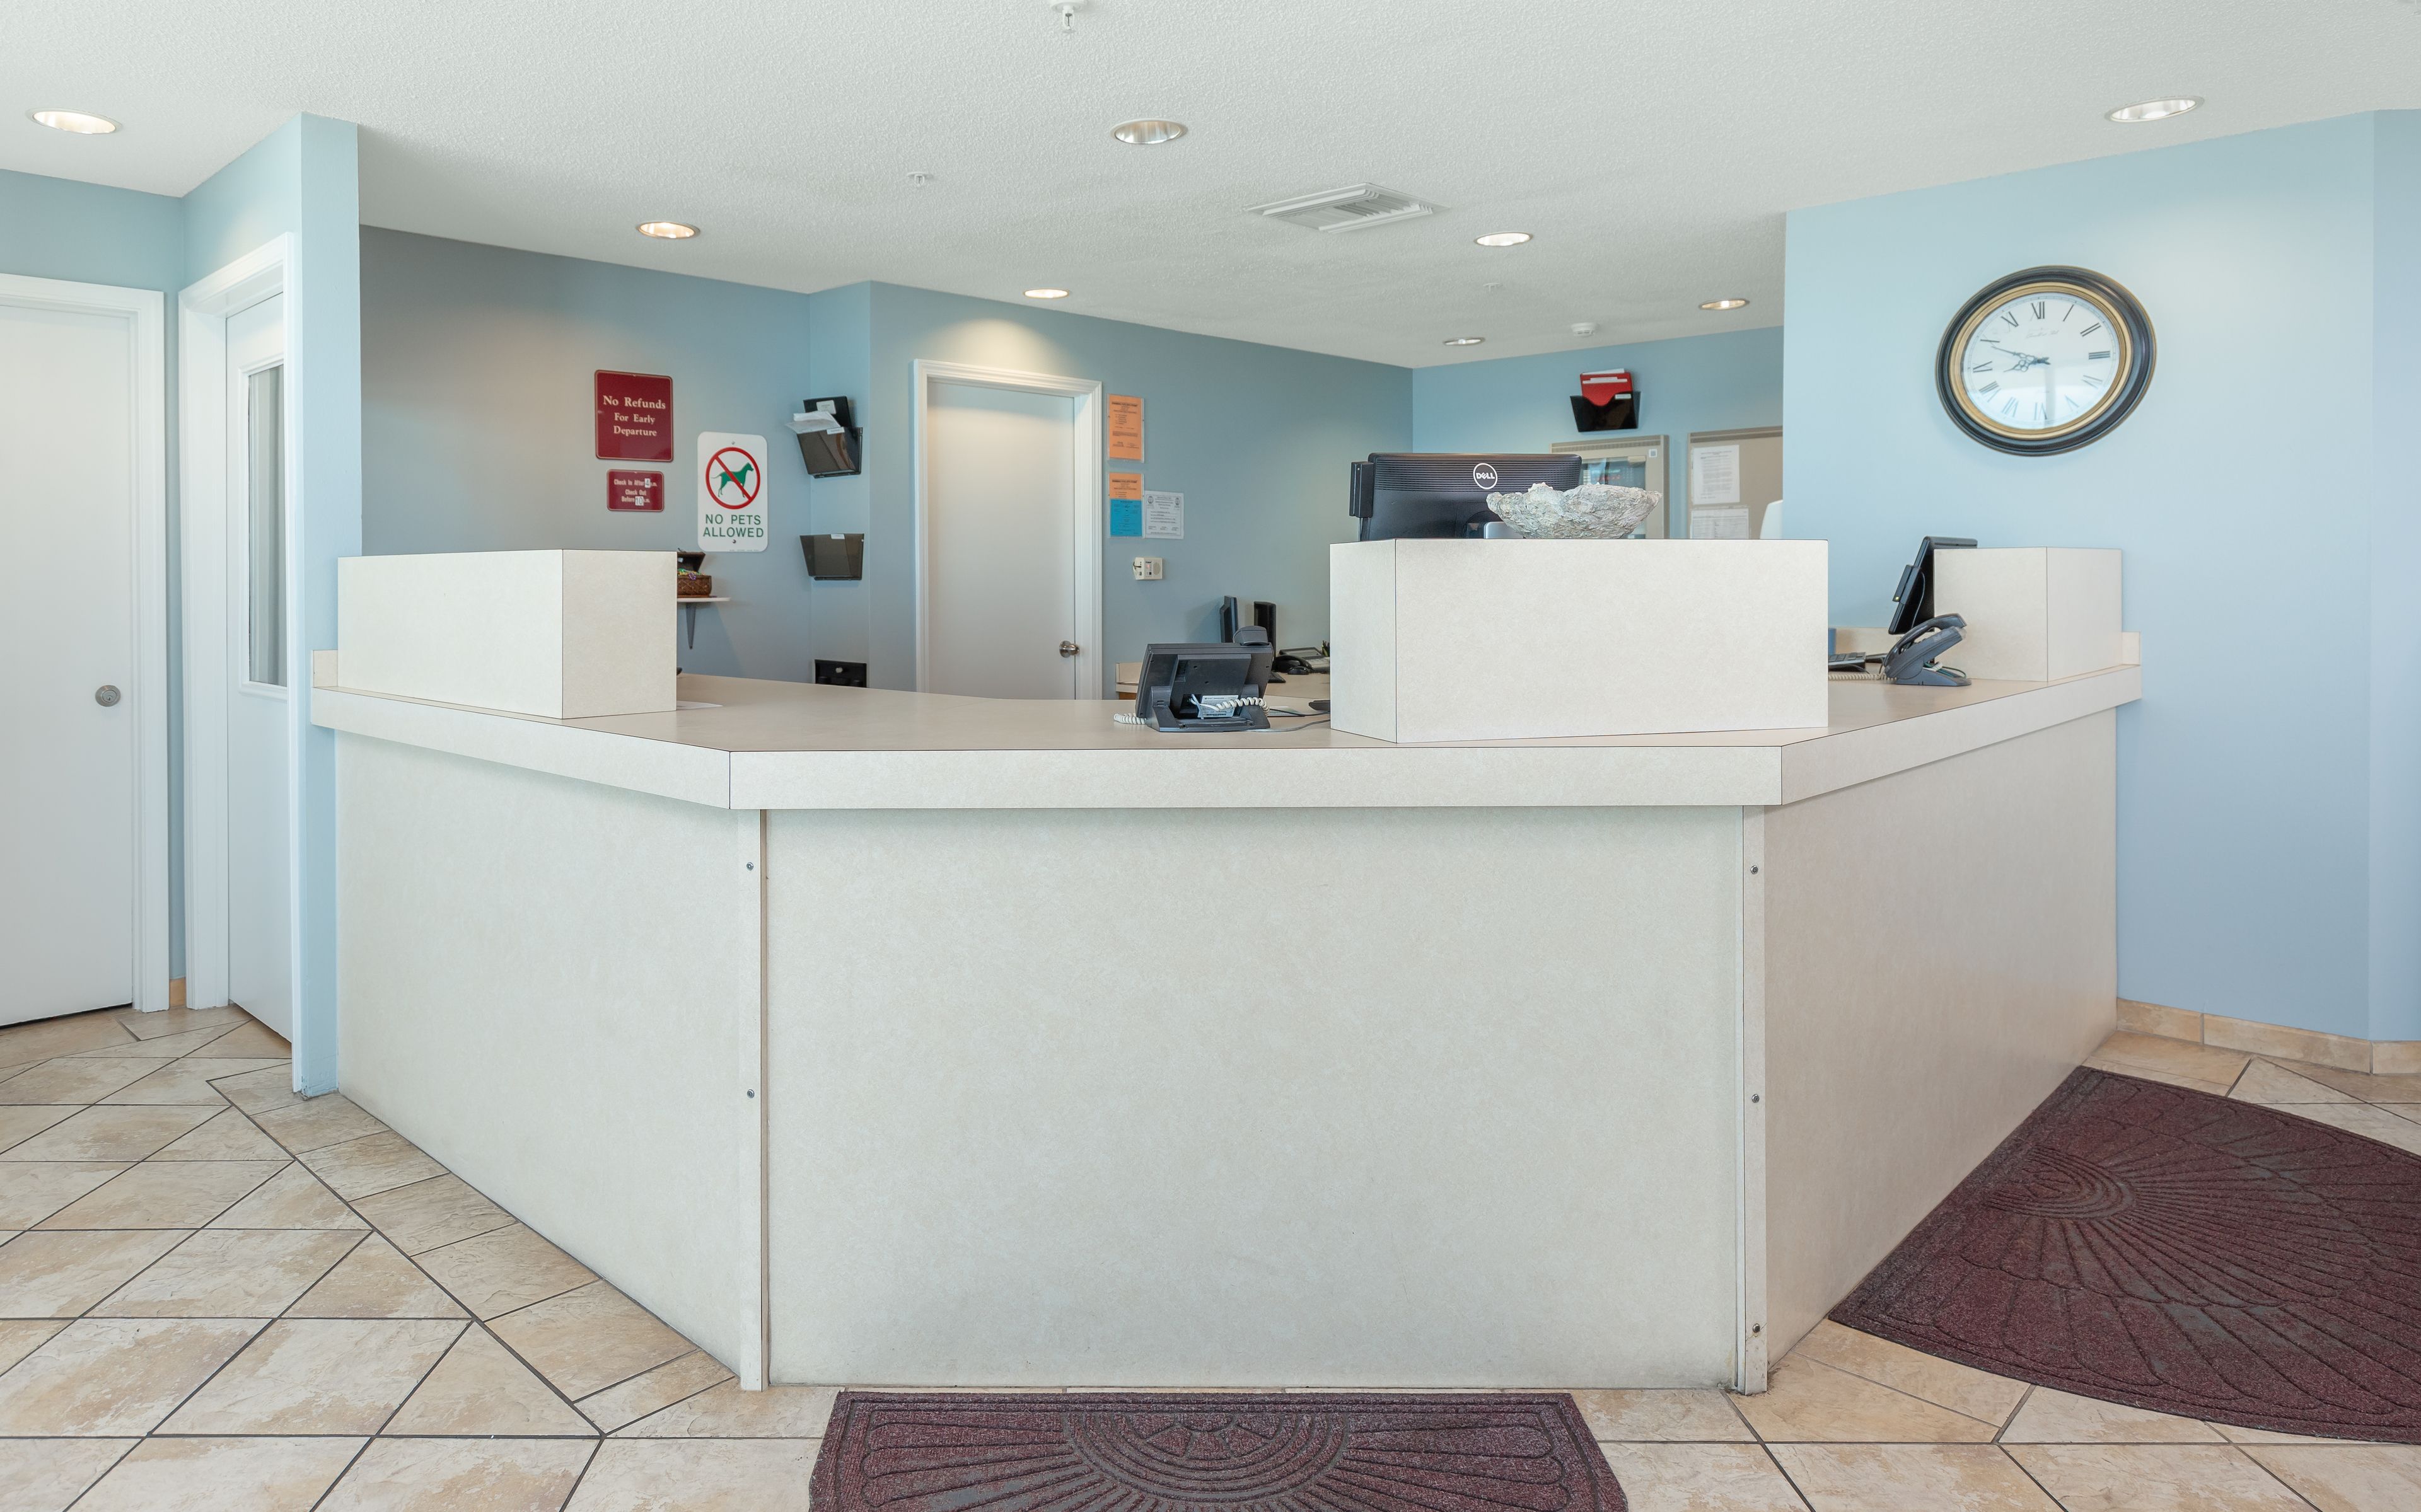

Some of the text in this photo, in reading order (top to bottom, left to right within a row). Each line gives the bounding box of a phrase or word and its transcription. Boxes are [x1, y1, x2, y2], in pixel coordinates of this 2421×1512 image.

[2030, 301, 2045, 322] XII
[2088, 350, 2111, 360] III
[603, 395, 666, 409] No Refunds
[614, 412, 656, 425] For Early
[613, 425, 657, 437] Departure
[705, 514, 761, 525] NO PETS
[703, 527, 764, 538] ALLOWED
